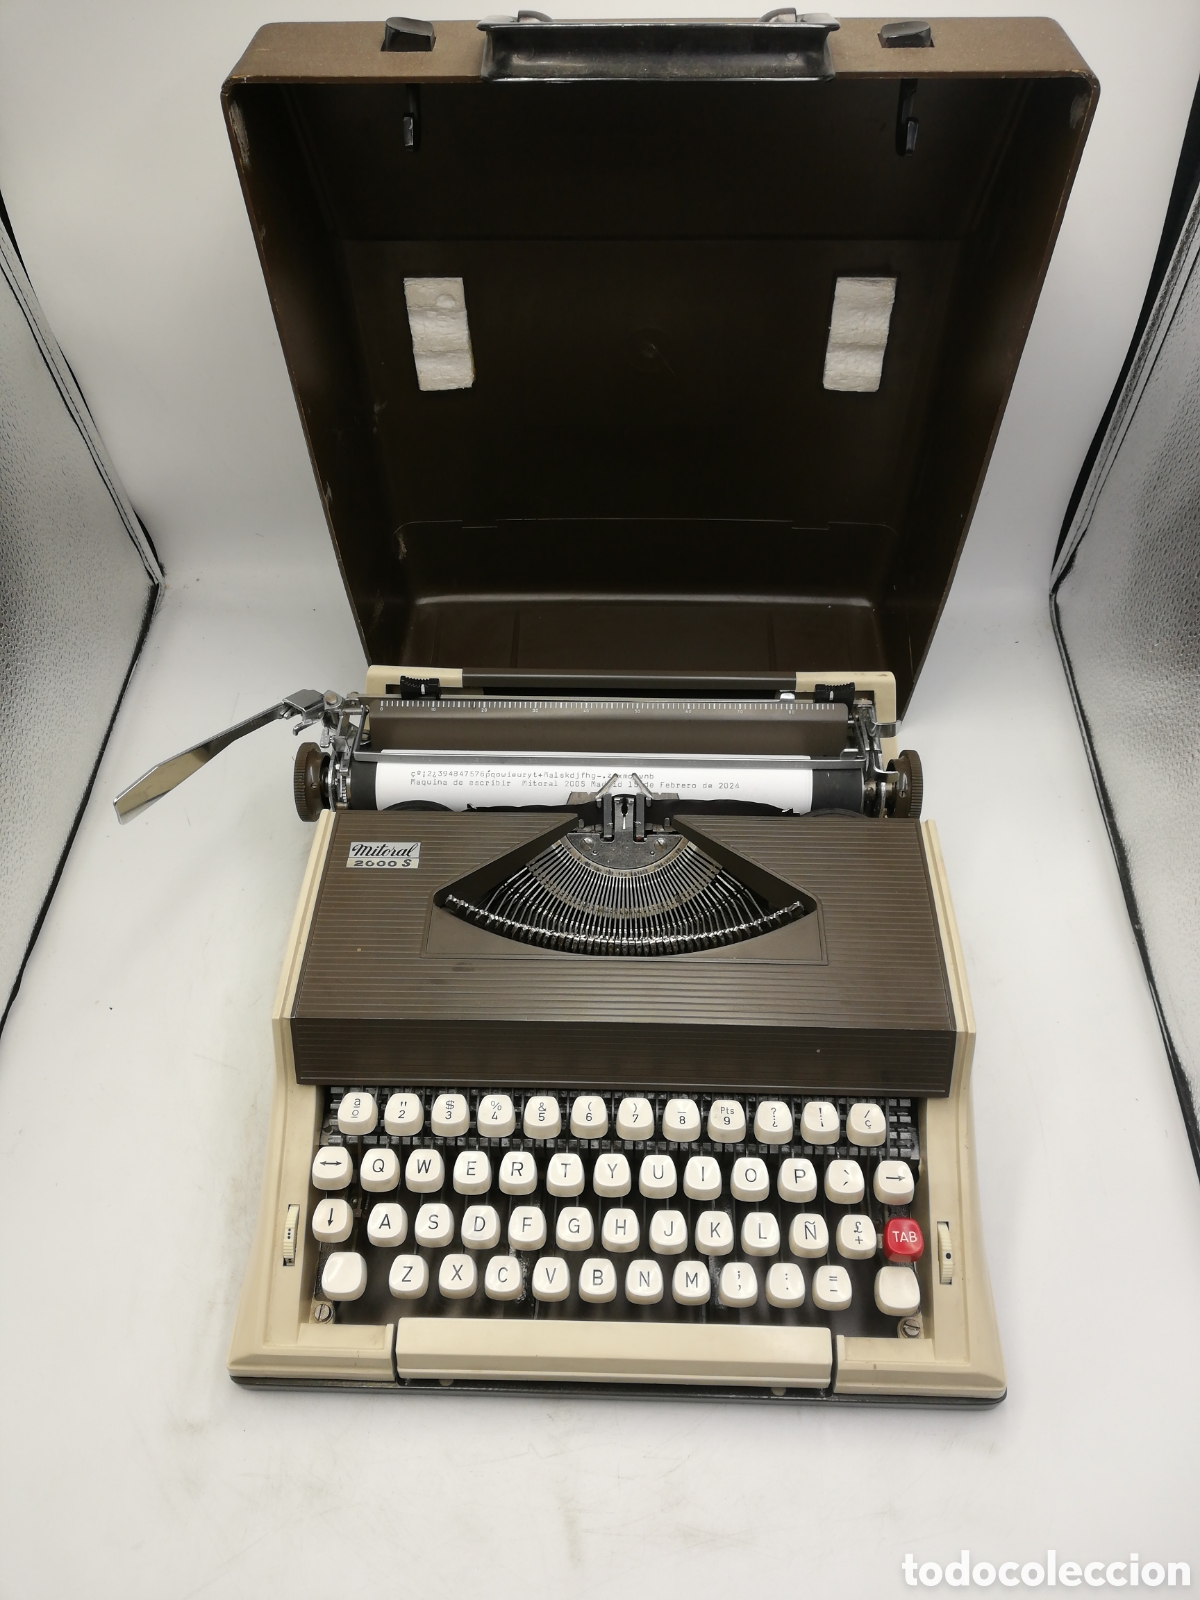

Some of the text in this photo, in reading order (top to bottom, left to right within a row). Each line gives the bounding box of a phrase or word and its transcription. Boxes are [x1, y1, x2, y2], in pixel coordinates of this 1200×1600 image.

[660, 781, 697, 789] Febrero
[718, 782, 740, 790] 2024
[352, 842, 418, 857] Mitoral
[401, 858, 412, 867] S
[445, 1100, 455, 1110] $
[490, 1100, 502, 1111] %
[537, 1102, 547, 1112] &
[720, 1106, 735, 1115] Pts
[397, 1110, 406, 1119] 2
[445, 1110, 452, 1120] 3
[491, 1111, 498, 1121] 4
[538, 1112, 546, 1122] 5
[585, 1112, 593, 1122] 6
[632, 1113, 639, 1123] 7
[679, 1115, 686, 1125] 8
[723, 1116, 731, 1126] 9
[372, 1158, 385, 1173] Q
[416, 1159, 432, 1174] W
[466, 1161, 477, 1176] E
[510, 1161, 524, 1177] R
[560, 1162, 571, 1178] T
[607, 1163, 618, 1179] Y
[652, 1164, 664, 1180] U
[701, 1166, 705, 1182] I
[744, 1168, 757, 1183] O
[794, 1168, 806, 1184] P
[378, 1213, 391, 1230] A
[428, 1214, 439, 1230] S
[473, 1216, 486, 1232] D
[522, 1216, 533, 1233] F
[568, 1217, 580, 1234] G
[615, 1218, 627, 1236] H
[663, 1220, 674, 1237] J
[710, 1221, 721, 1238] K
[758, 1222, 768, 1240] L
[804, 1220, 817, 1241] Ñ
[891, 1230, 918, 1243] TAB
[401, 1265, 414, 1283] Z
[451, 1264, 464, 1281] X
[497, 1266, 509, 1283] C
[545, 1267, 557, 1285] V
[592, 1269, 604, 1286] B
[639, 1270, 650, 1288] N
[685, 1271, 698, 1289] M
